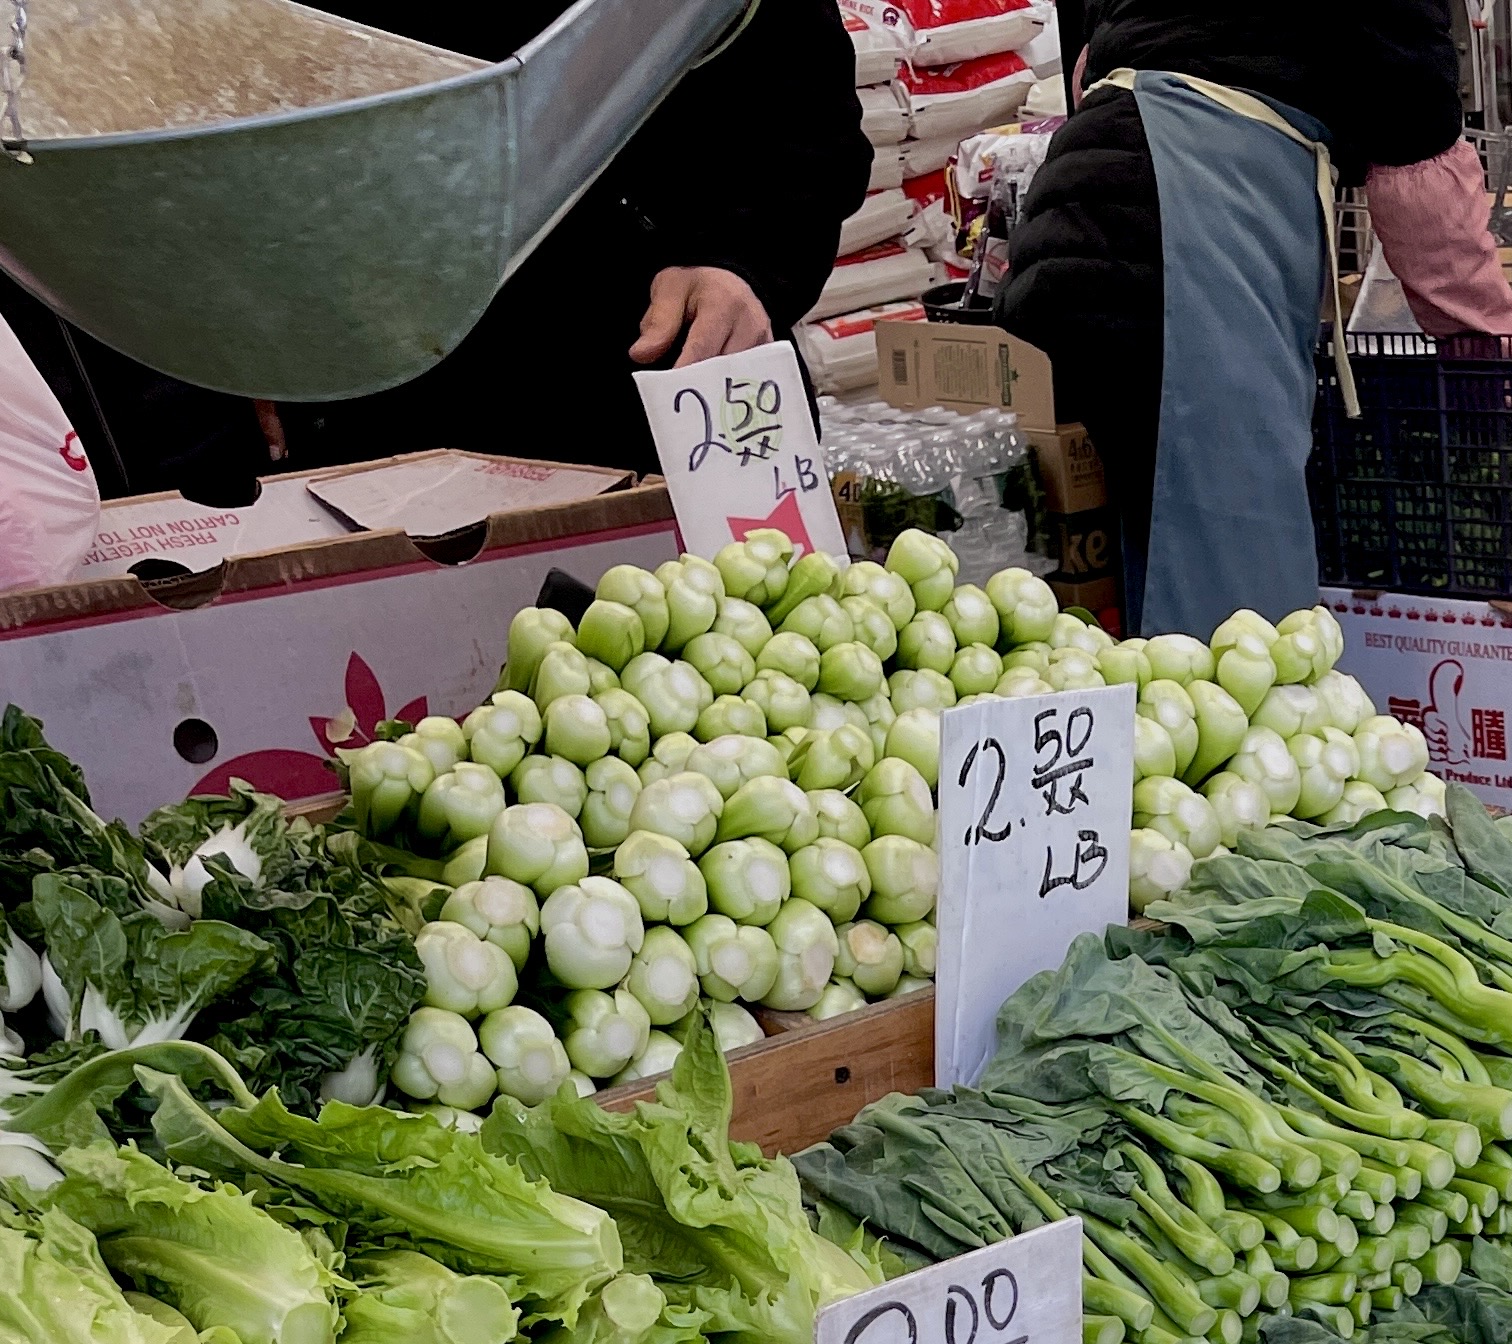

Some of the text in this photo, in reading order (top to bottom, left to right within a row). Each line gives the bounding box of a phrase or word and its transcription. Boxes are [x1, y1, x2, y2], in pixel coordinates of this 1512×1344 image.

[674, 378, 782, 472] 2.50
[774, 455, 819, 500] LB
[98, 513, 240, 545] CARTON NOT TO
[157, 531, 218, 552] FRESH
[1365, 631, 1393, 649] BEST
[1394, 634, 1447, 654] QUALITY
[958, 706, 1095, 846] 2.50
[1445, 768, 1492, 787] Produce
[1038, 829, 1108, 899] LB
